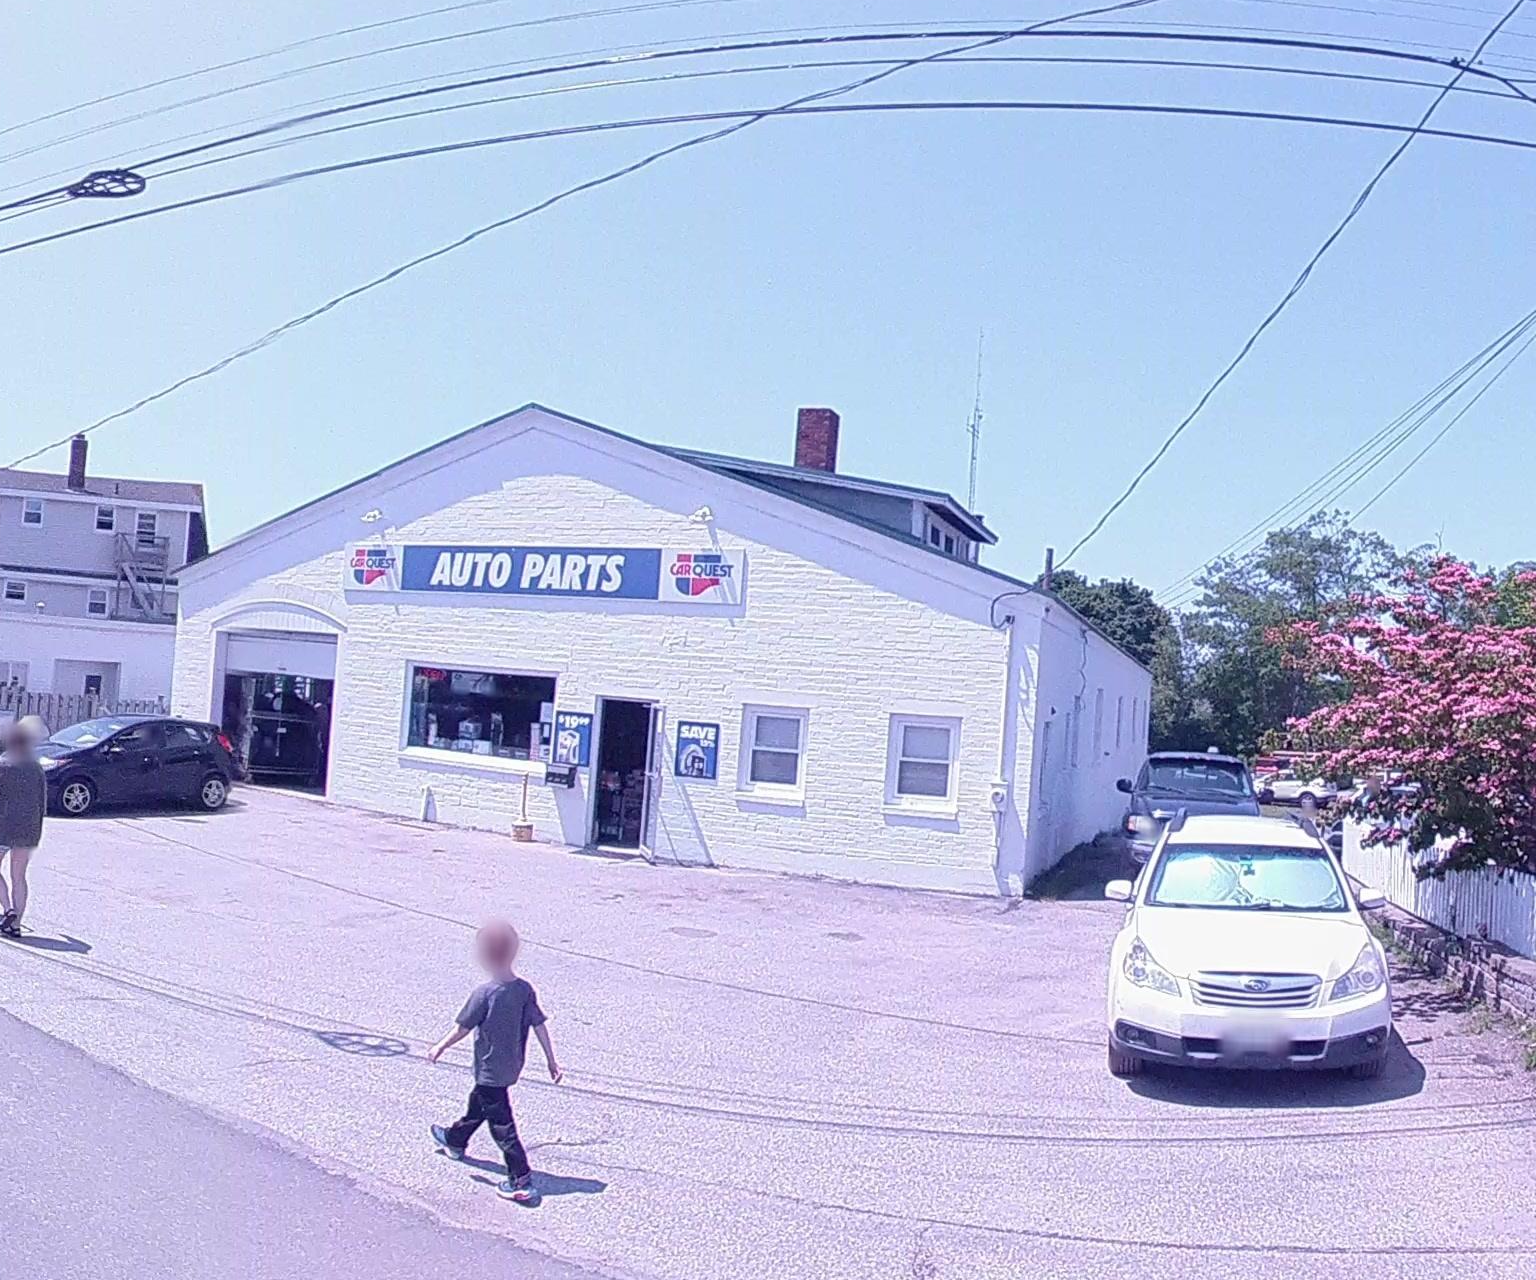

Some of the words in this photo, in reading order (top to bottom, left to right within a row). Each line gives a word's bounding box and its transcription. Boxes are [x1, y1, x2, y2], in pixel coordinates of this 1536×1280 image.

[429, 552, 513, 588] AUTO
[519, 553, 625, 593] PARTS
[680, 725, 716, 740] SAVE
